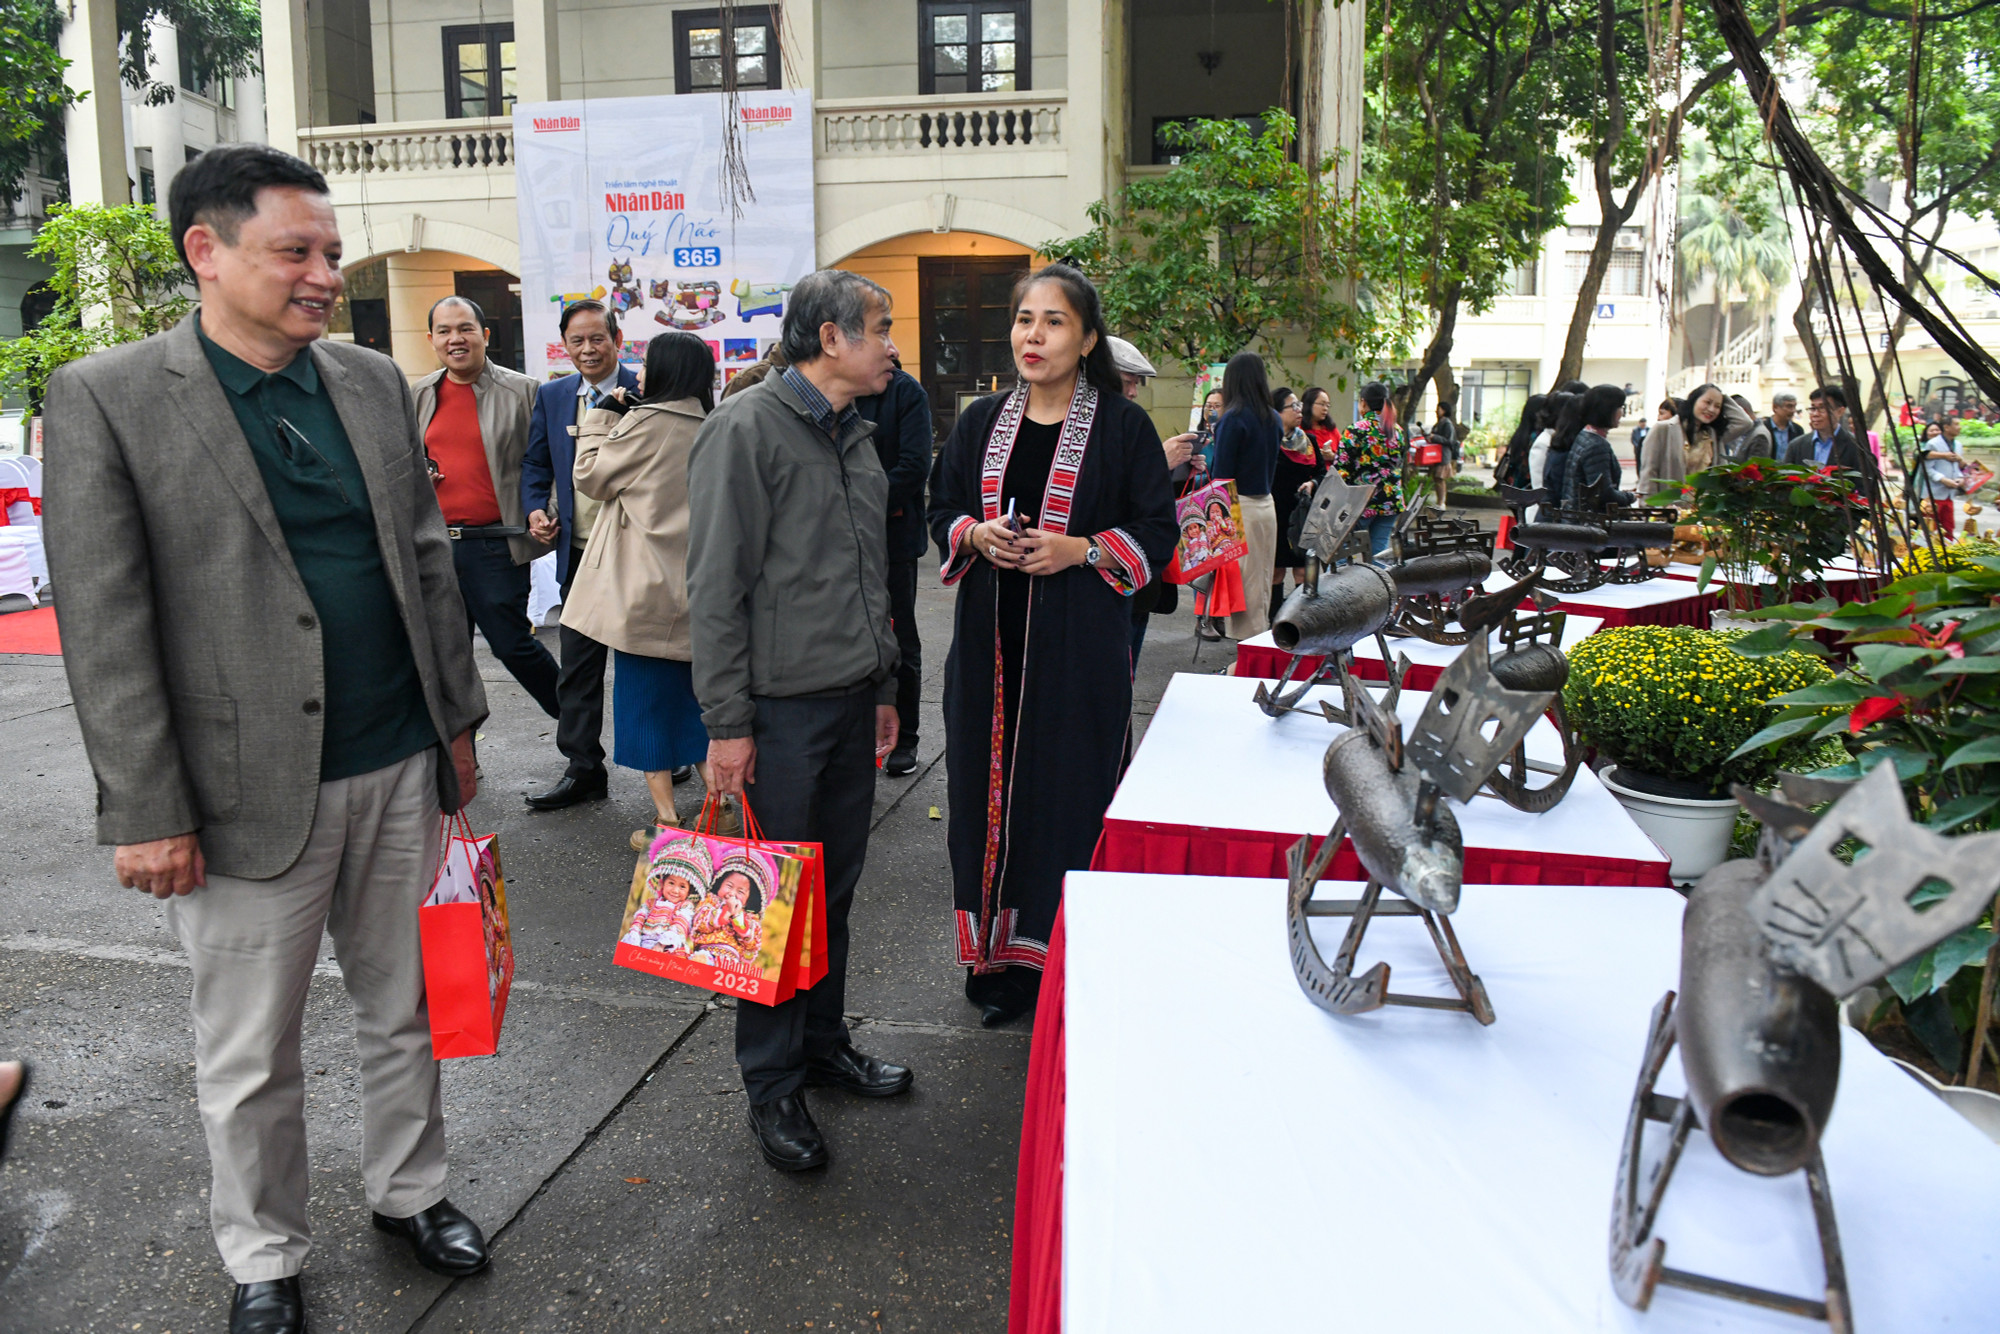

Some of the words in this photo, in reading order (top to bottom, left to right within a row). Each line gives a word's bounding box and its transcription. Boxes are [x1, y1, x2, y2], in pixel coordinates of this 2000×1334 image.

[740, 106, 769, 119] Nhân
[770, 105, 792, 118] Dân
[533, 116, 559, 130] Nhân
[560, 116, 580, 128] Dân
[605, 192, 649, 213] Nhân
[651, 190, 685, 211] Dân
[606, 214, 659, 257] Quý
[664, 212, 721, 255] Mão
[677, 248, 717, 267] 365
[1600, 305, 1613, 317] A
[713, 970, 759, 995] 2023
